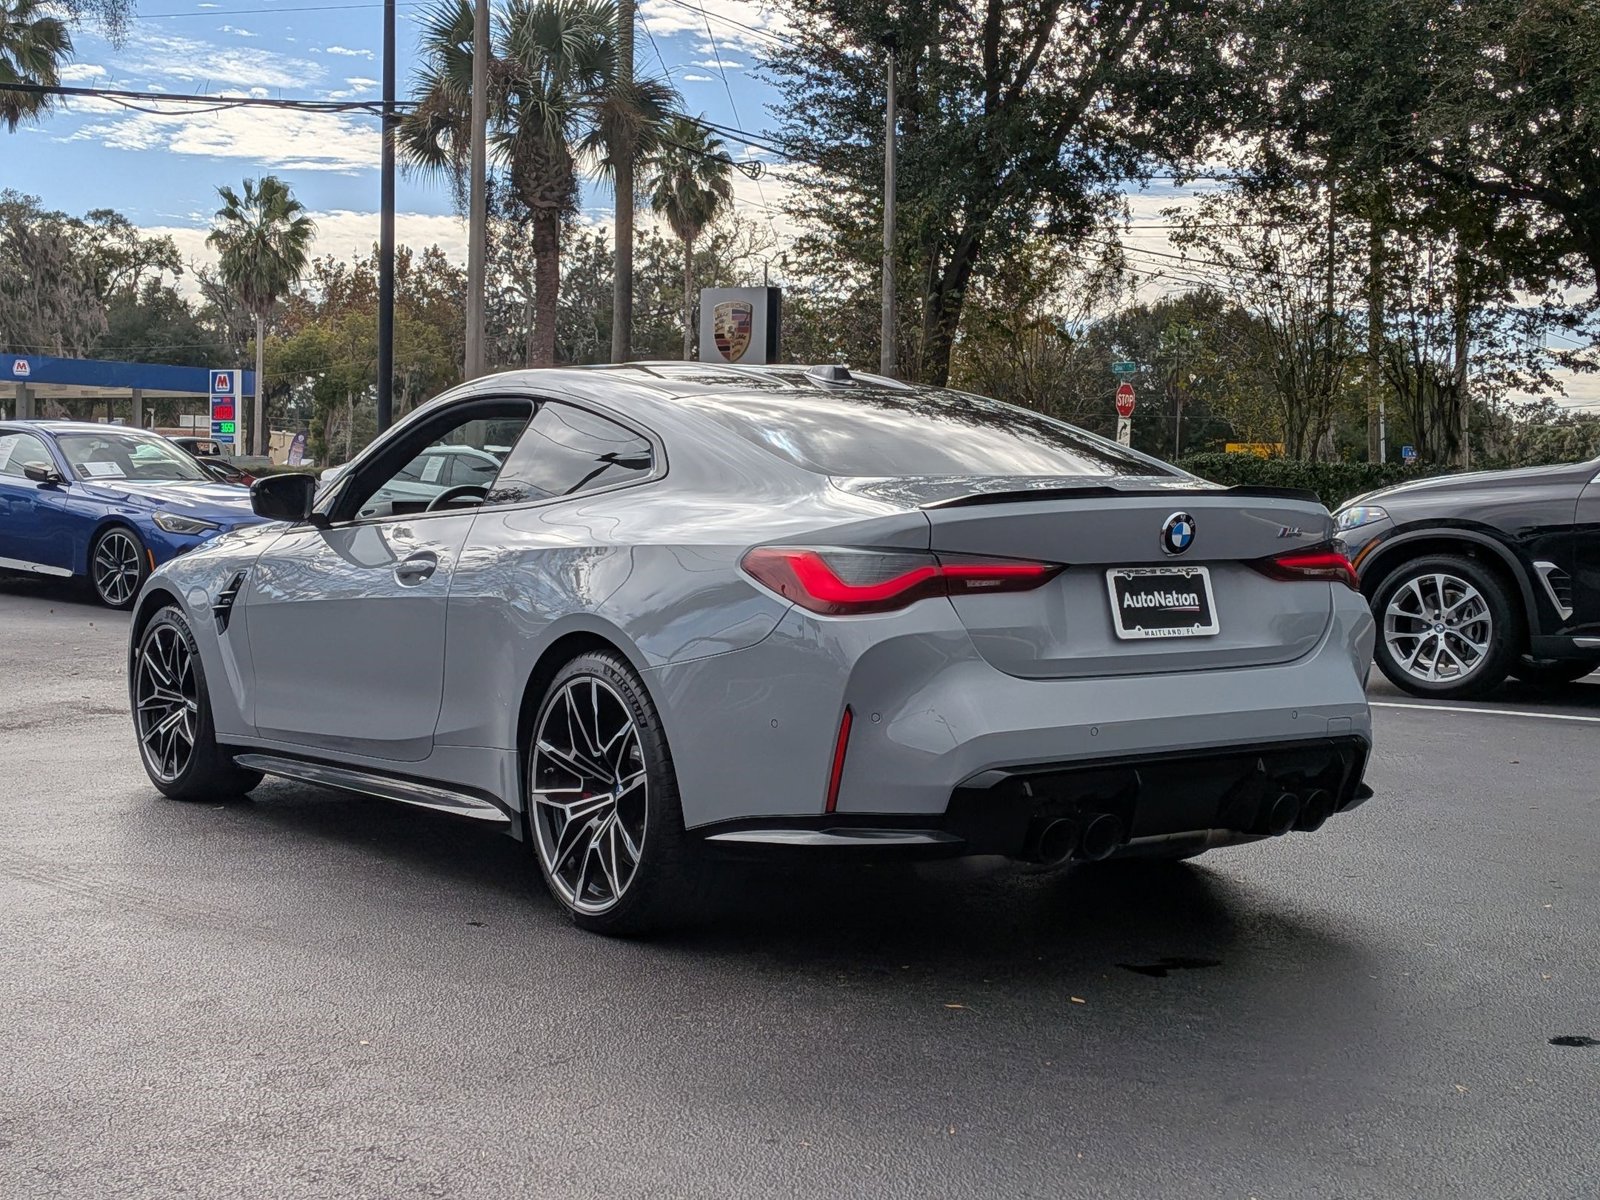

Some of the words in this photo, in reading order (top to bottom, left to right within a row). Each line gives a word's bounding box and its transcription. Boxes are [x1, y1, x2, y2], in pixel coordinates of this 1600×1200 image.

[217, 375, 228, 388] M
[1117, 393, 1133, 407] STOP
[1123, 590, 1199, 608] AutoNation
[610, 668, 649, 728] MICHELIN
